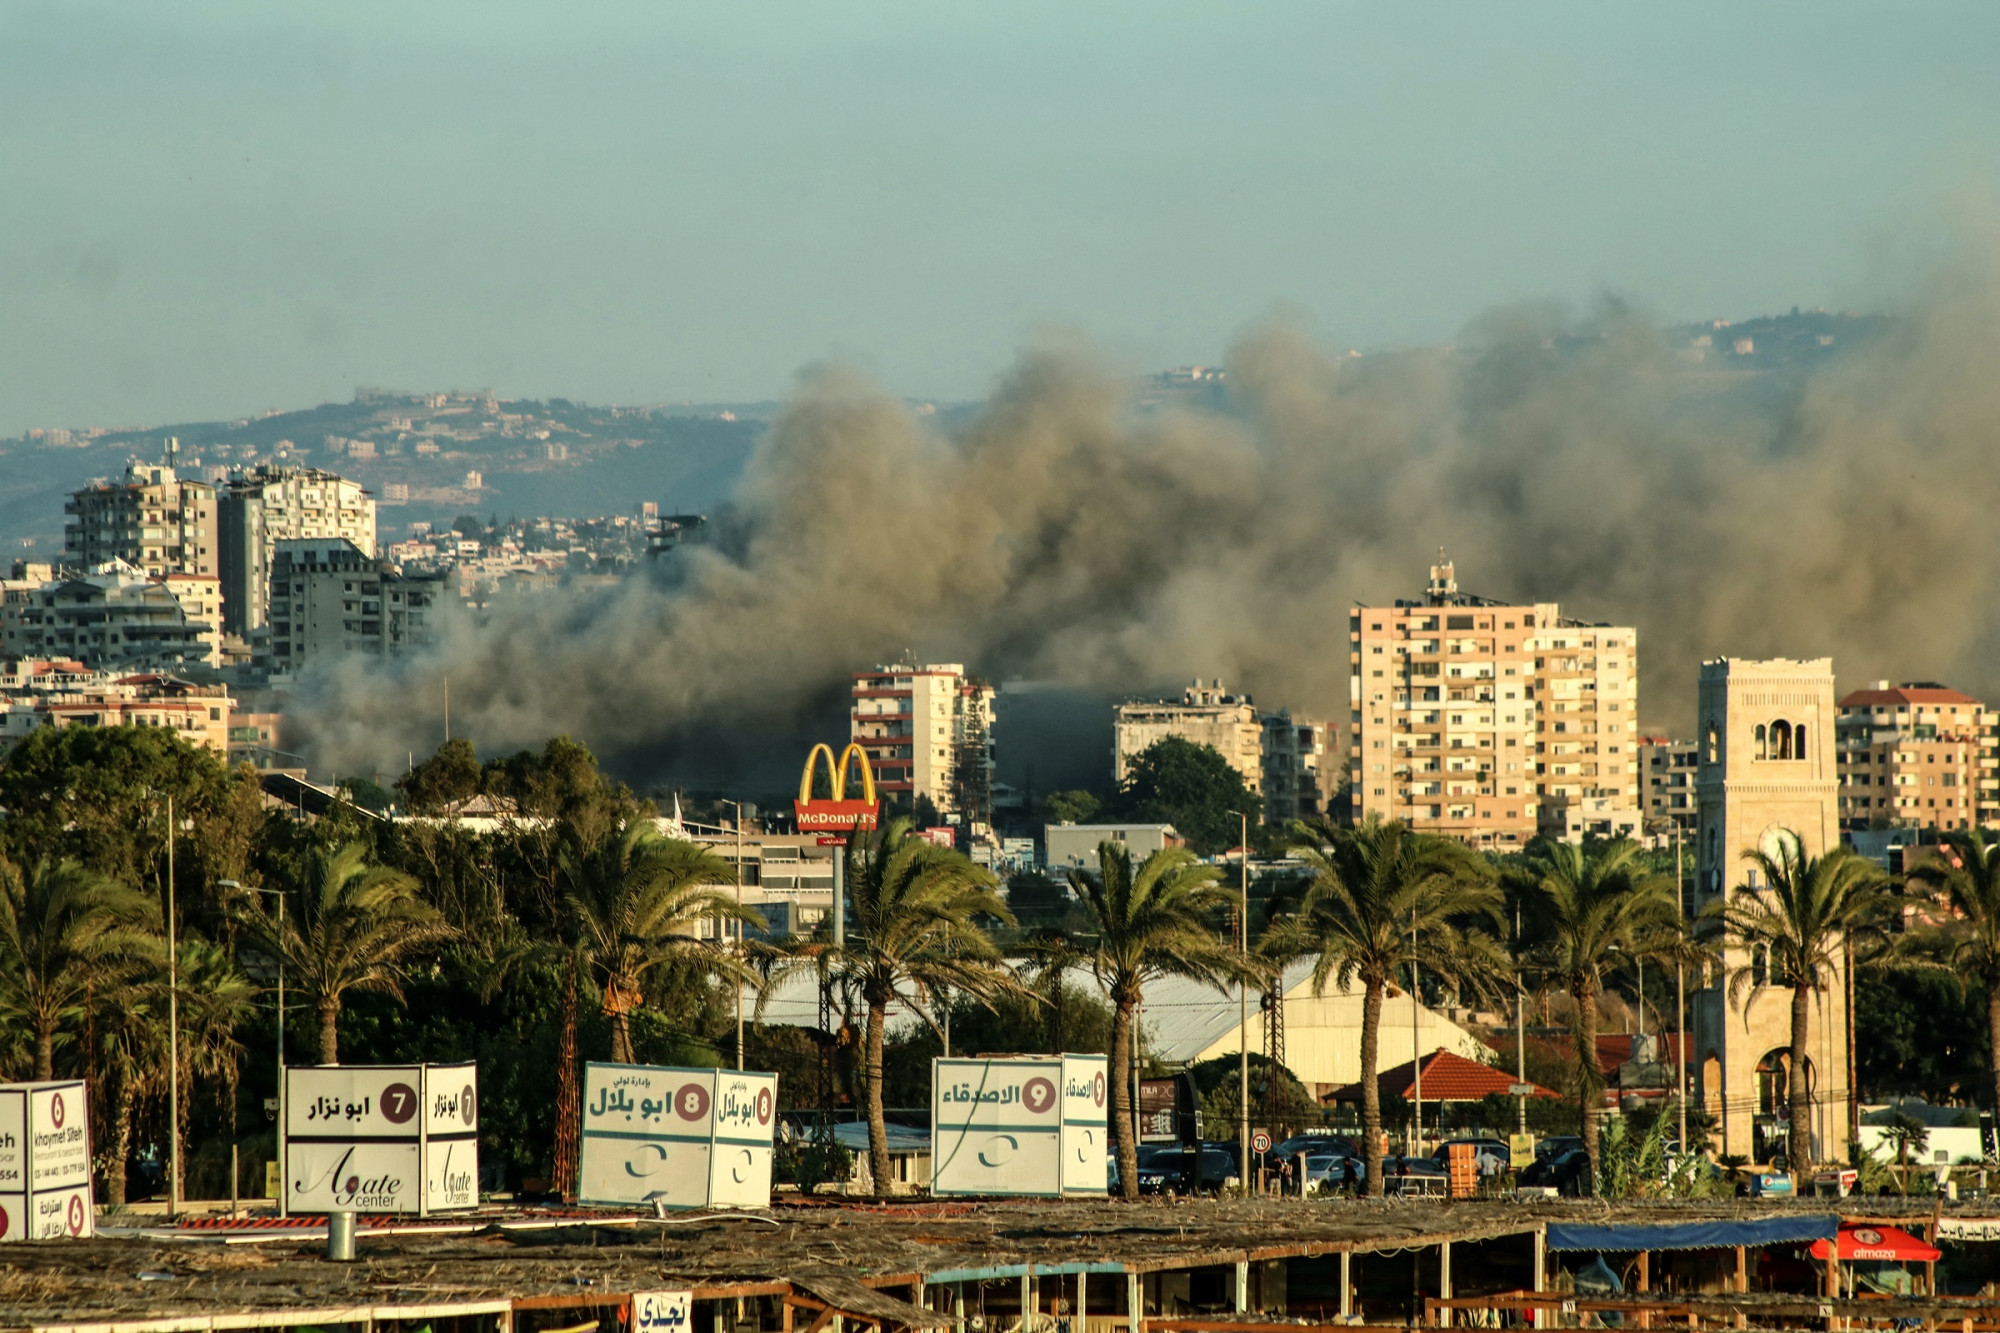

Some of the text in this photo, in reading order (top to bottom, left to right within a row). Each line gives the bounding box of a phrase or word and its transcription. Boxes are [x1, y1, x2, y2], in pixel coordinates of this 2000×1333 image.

[798, 812, 876, 824] McDonald's
[943, 1082, 1020, 1104] الاصدقاء
[1031, 1084, 1047, 1106] 9
[1097, 1078, 1103, 1101] 9
[55, 1097, 62, 1122] 6
[308, 1096, 370, 1122] ابو نزار
[392, 1093, 406, 1114] 7
[434, 1093, 458, 1119] ابو نزار
[465, 1095, 471, 1116] 7
[590, 1087, 672, 1123] ابو بلال
[685, 1092, 699, 1113] 8
[718, 1093, 756, 1127] ابو بلال
[761, 1096, 768, 1117] 8
[1256, 1138, 1266, 1148] 70
[295, 1145, 404, 1206] Agate
[355, 1193, 396, 1208] center
[71, 1199, 80, 1228] 6
[1854, 1247, 1895, 1260] almaza
